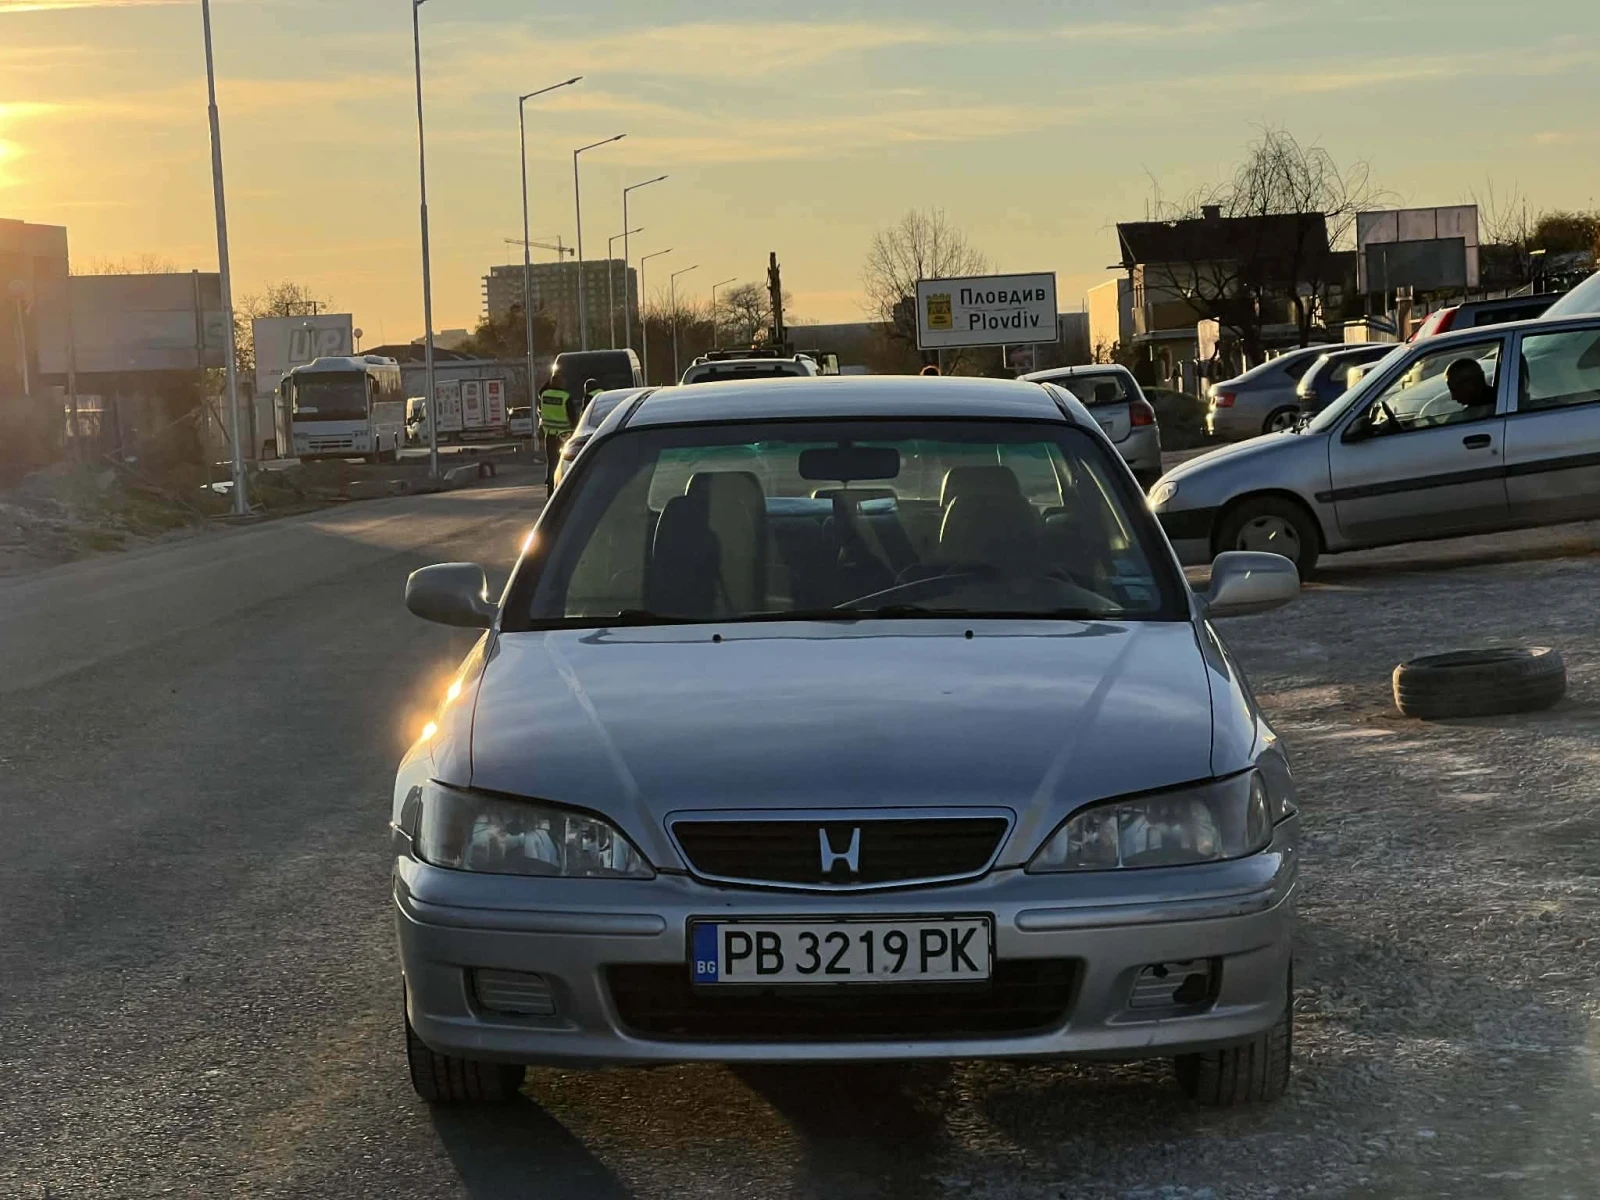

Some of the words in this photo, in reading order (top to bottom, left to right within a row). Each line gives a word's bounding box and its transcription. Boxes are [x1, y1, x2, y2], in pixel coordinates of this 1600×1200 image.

[960, 288, 1046, 305] Пловдив
[969, 311, 1039, 331] Plovdiv
[725, 930, 784, 976] PB
[796, 929, 909, 975] 3219
[920, 927, 979, 974] PK
[696, 960, 716, 974] BG
